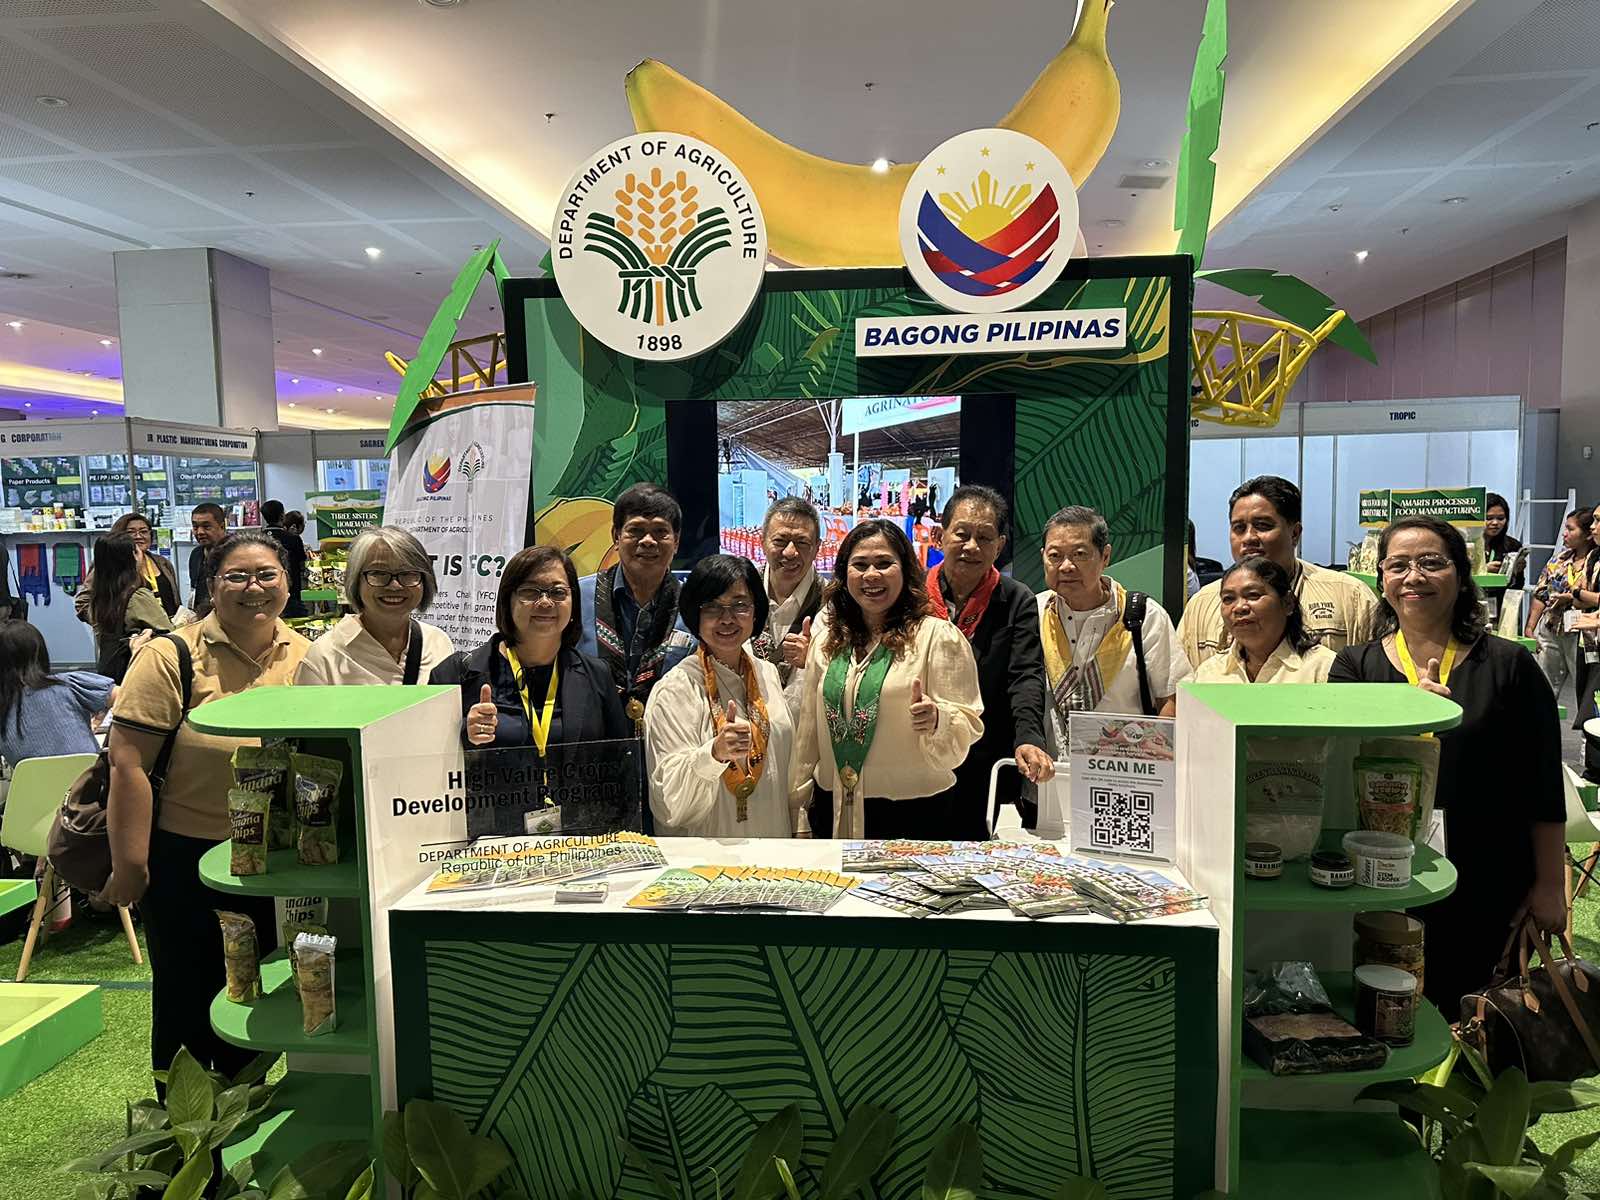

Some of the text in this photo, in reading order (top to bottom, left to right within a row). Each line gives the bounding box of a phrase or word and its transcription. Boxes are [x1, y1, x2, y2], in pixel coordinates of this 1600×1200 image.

[559, 141, 757, 260] DEPARTMENT OF AGRICULTURE
[864, 318, 1120, 347] BAGONG PILIPINAS
[636, 334, 683, 352] 1898
[865, 396, 929, 417] AGRINAT
[1389, 411, 1417, 421] TROPIC
[156, 434, 177, 444] PLASTIC
[8, 477, 51, 486] Paper Products
[1432, 497, 1477, 506] PROCESSED
[331, 512, 378, 520] THREE SISTERS
[1395, 506, 1481, 516] FOOD MANUFACTURING
[332, 528, 357, 536] BANANA
[443, 555, 463, 576] IS
[477, 590, 497, 600] (YFC)
[474, 604, 495, 612] grant
[437, 613, 456, 621] under
[449, 625, 459, 633] for
[474, 628, 492, 636] who
[1088, 758, 1155, 775] SCAN ME
[448, 767, 495, 792] High
[502, 766, 556, 785] Value
[392, 781, 625, 817] Development Program
[419, 832, 620, 863] DEPARTMENT OF AGRICULTURE
[441, 845, 621, 874] Republic of the Philippines
